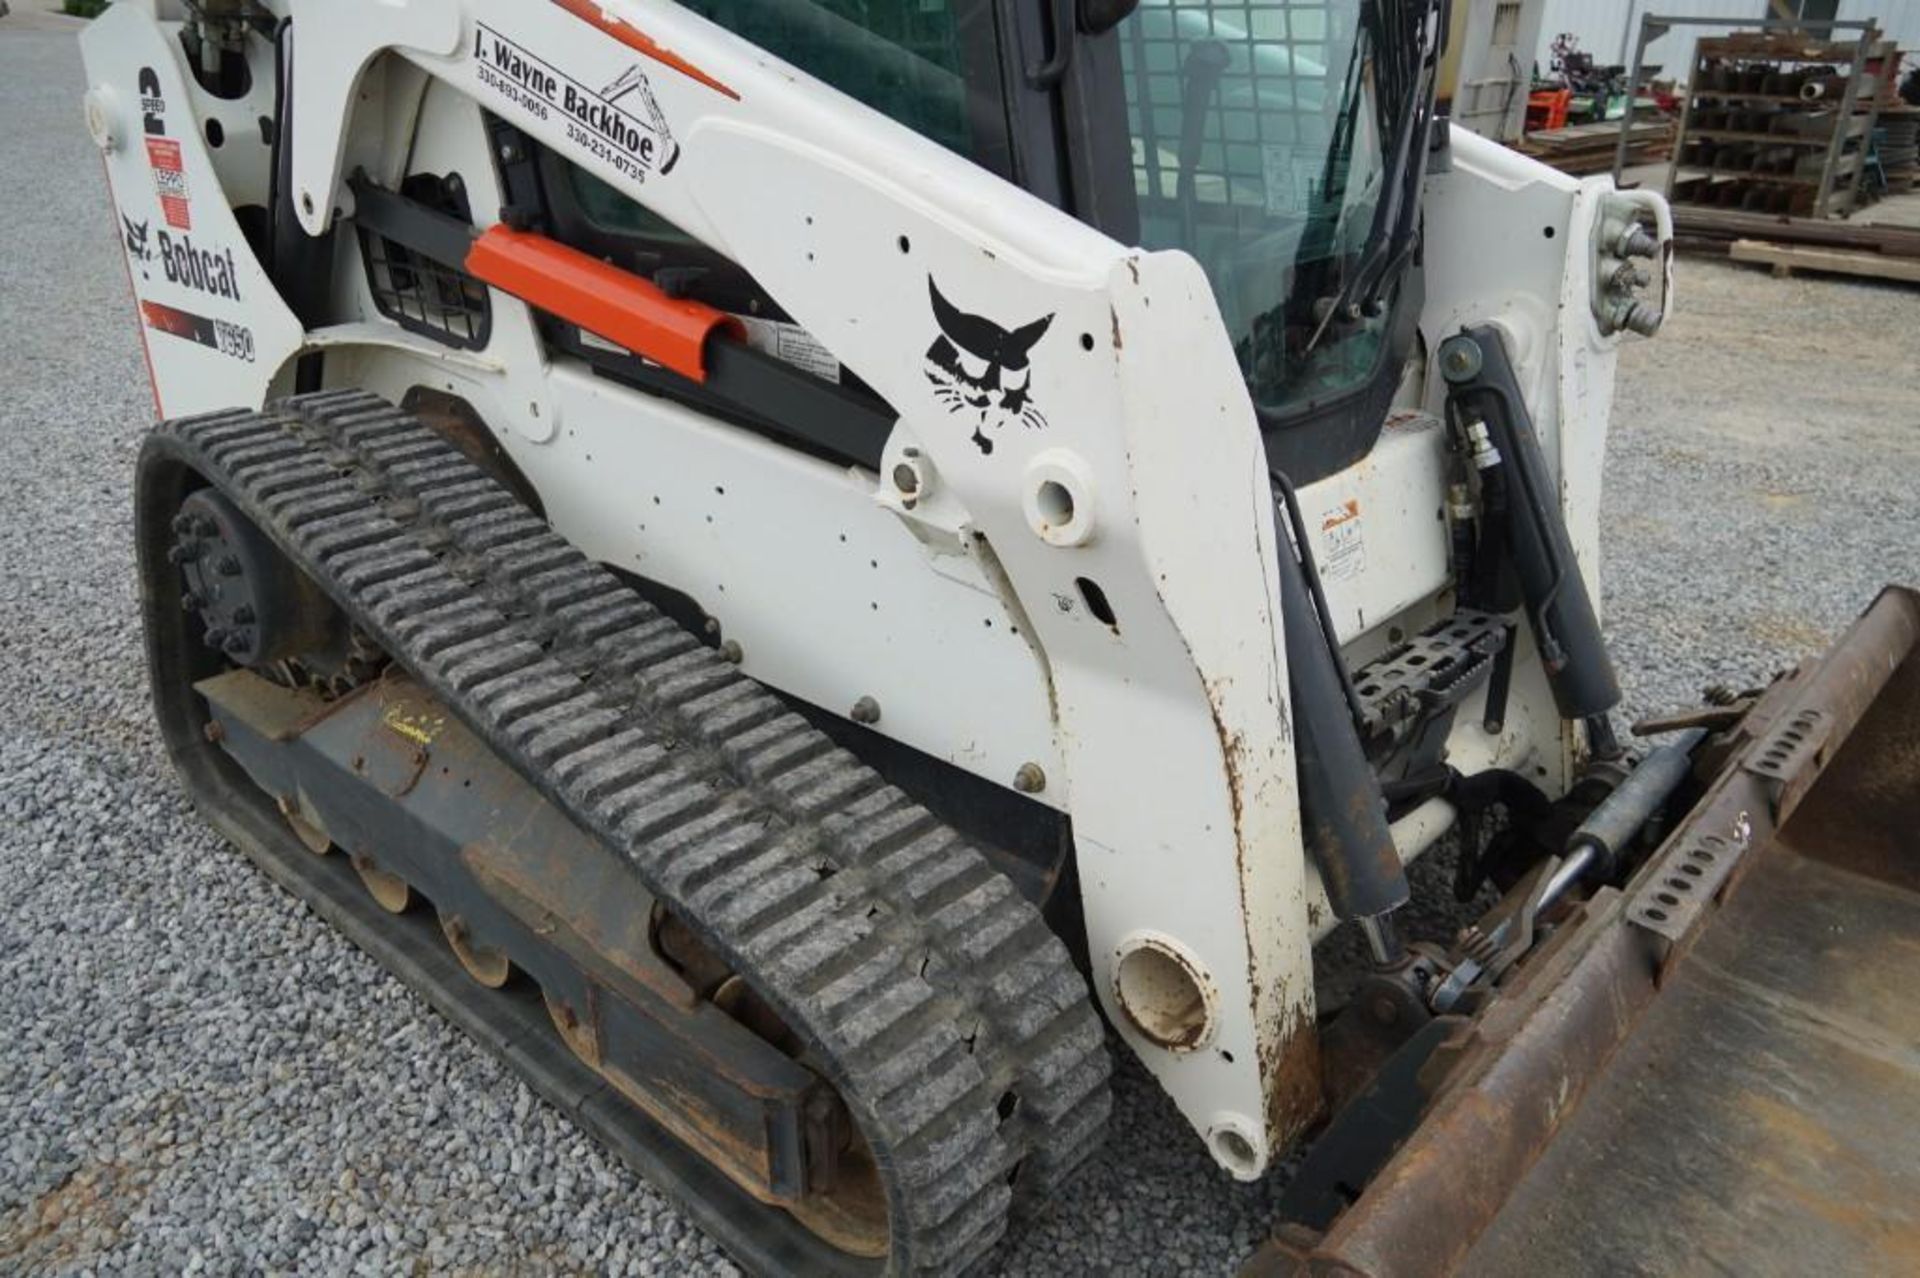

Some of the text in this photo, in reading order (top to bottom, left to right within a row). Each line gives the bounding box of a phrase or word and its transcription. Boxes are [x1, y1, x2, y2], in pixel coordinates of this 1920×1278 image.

[141, 97, 166, 113] SPEED
[474, 29, 654, 163] J. Wayne Backhoe
[157, 230, 241, 302] Bobcat
